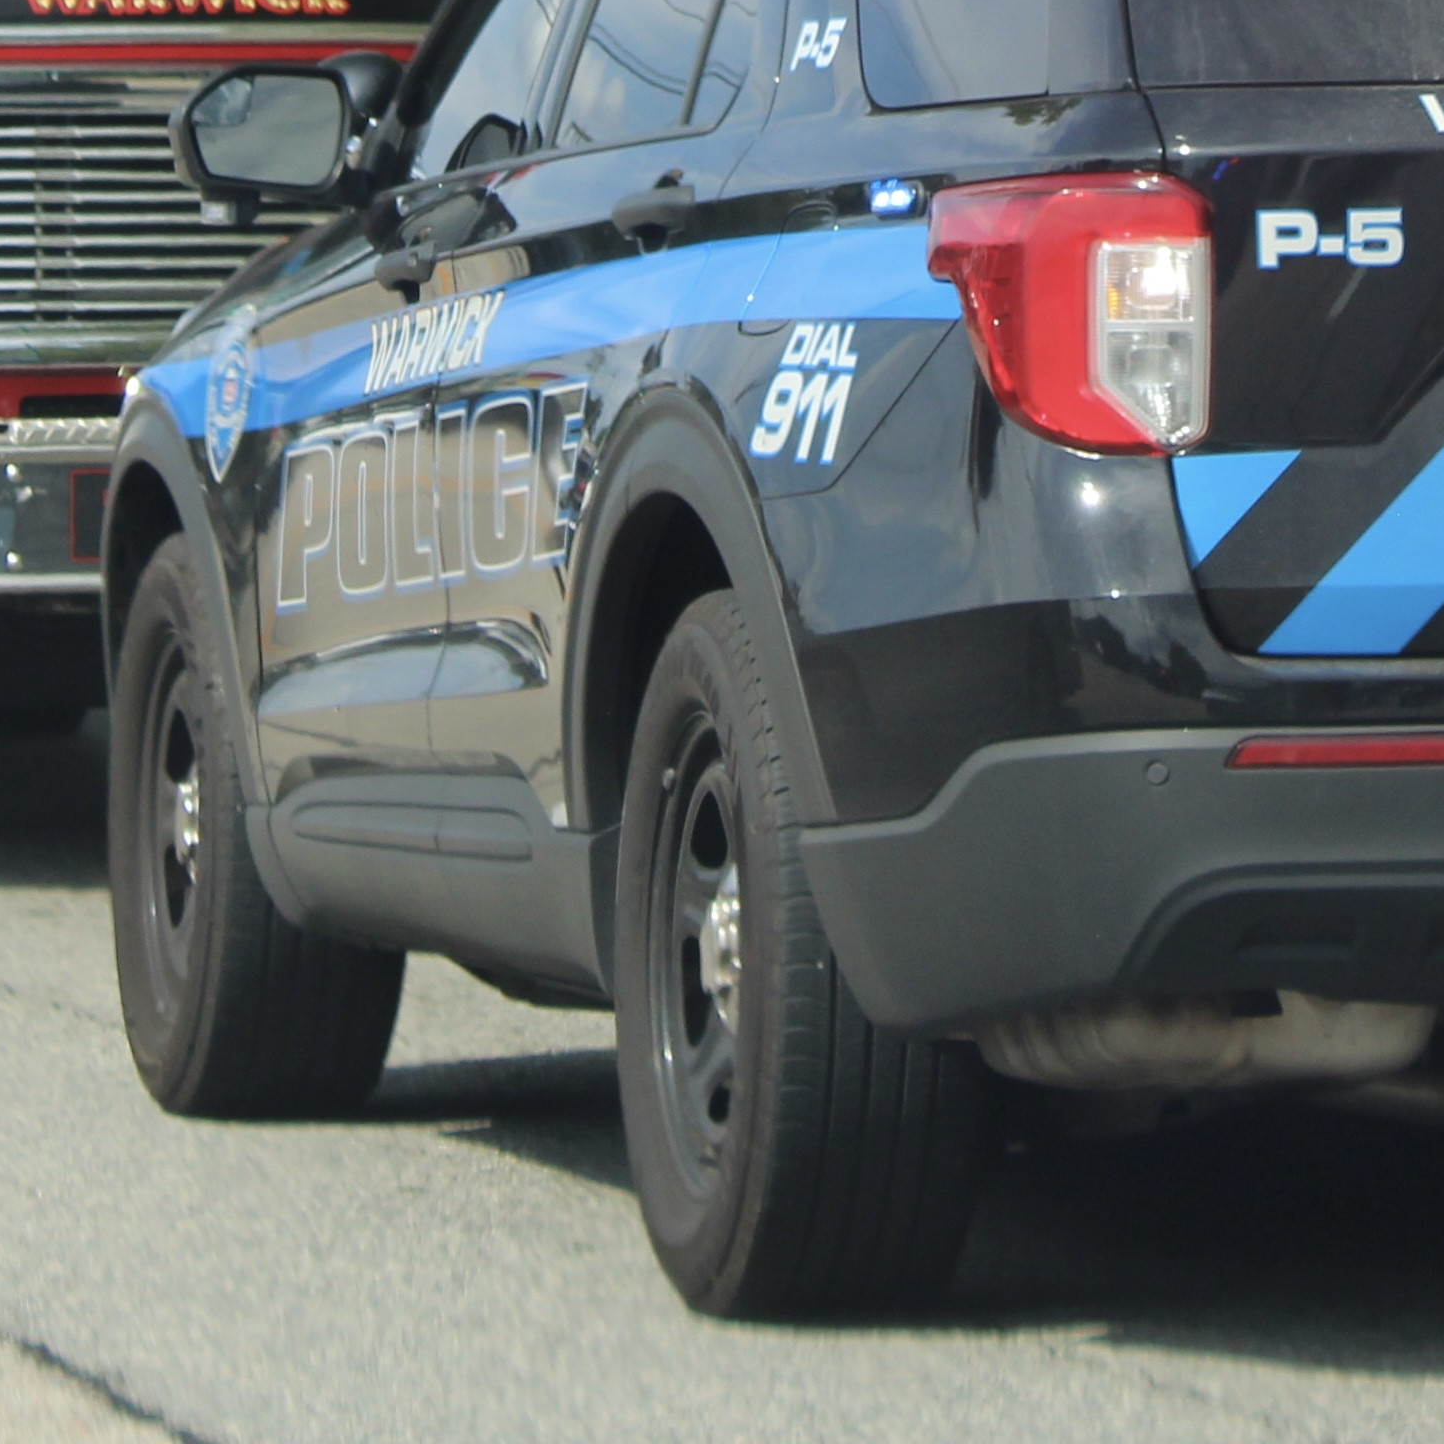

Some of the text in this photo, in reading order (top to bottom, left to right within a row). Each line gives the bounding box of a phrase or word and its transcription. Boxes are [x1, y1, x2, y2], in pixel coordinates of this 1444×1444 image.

[790, 17, 848, 72] P-5
[1256, 207, 1405, 269] P-5
[363, 289, 505, 396] WARWICK
[779, 321, 858, 371] DIAL
[750, 369, 854, 466] 911
[275, 380, 589, 613] POLICE
